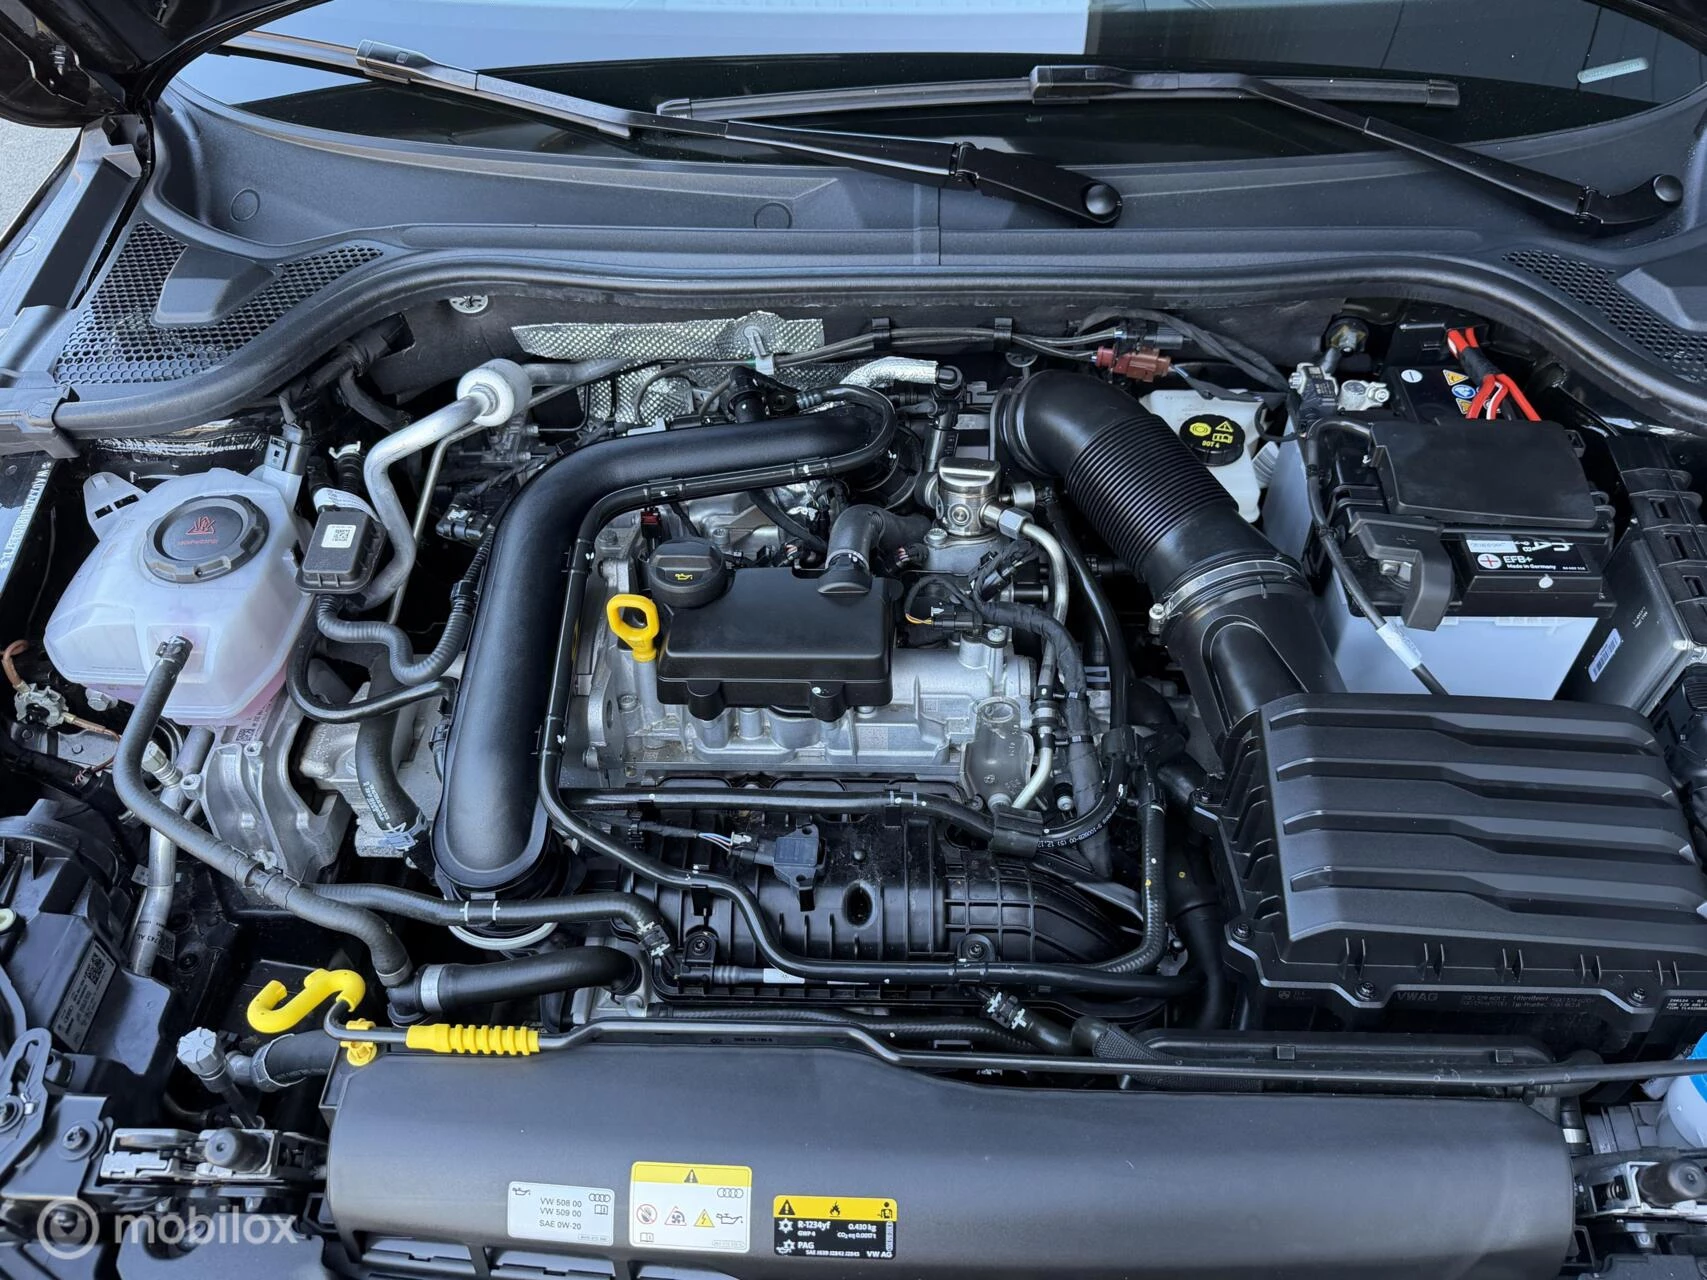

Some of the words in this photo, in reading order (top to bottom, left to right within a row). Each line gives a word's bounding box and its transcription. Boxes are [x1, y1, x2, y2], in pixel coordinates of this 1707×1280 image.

[1502, 555, 1533, 564] EFB+
[540, 1197, 555, 1206] VW
[556, 1199, 571, 1207] 508
[572, 1200, 583, 1208] 00
[540, 1207, 554, 1215] VW
[556, 1208, 571, 1217] 509
[572, 1210, 582, 1218] 00
[539, 1219, 555, 1228] SAE
[557, 1221, 582, 1230] 0W-20
[797, 1220, 831, 1231] R-1234yf
[868, 1223, 877, 1233] kg
[797, 1241, 815, 1249] PAG
